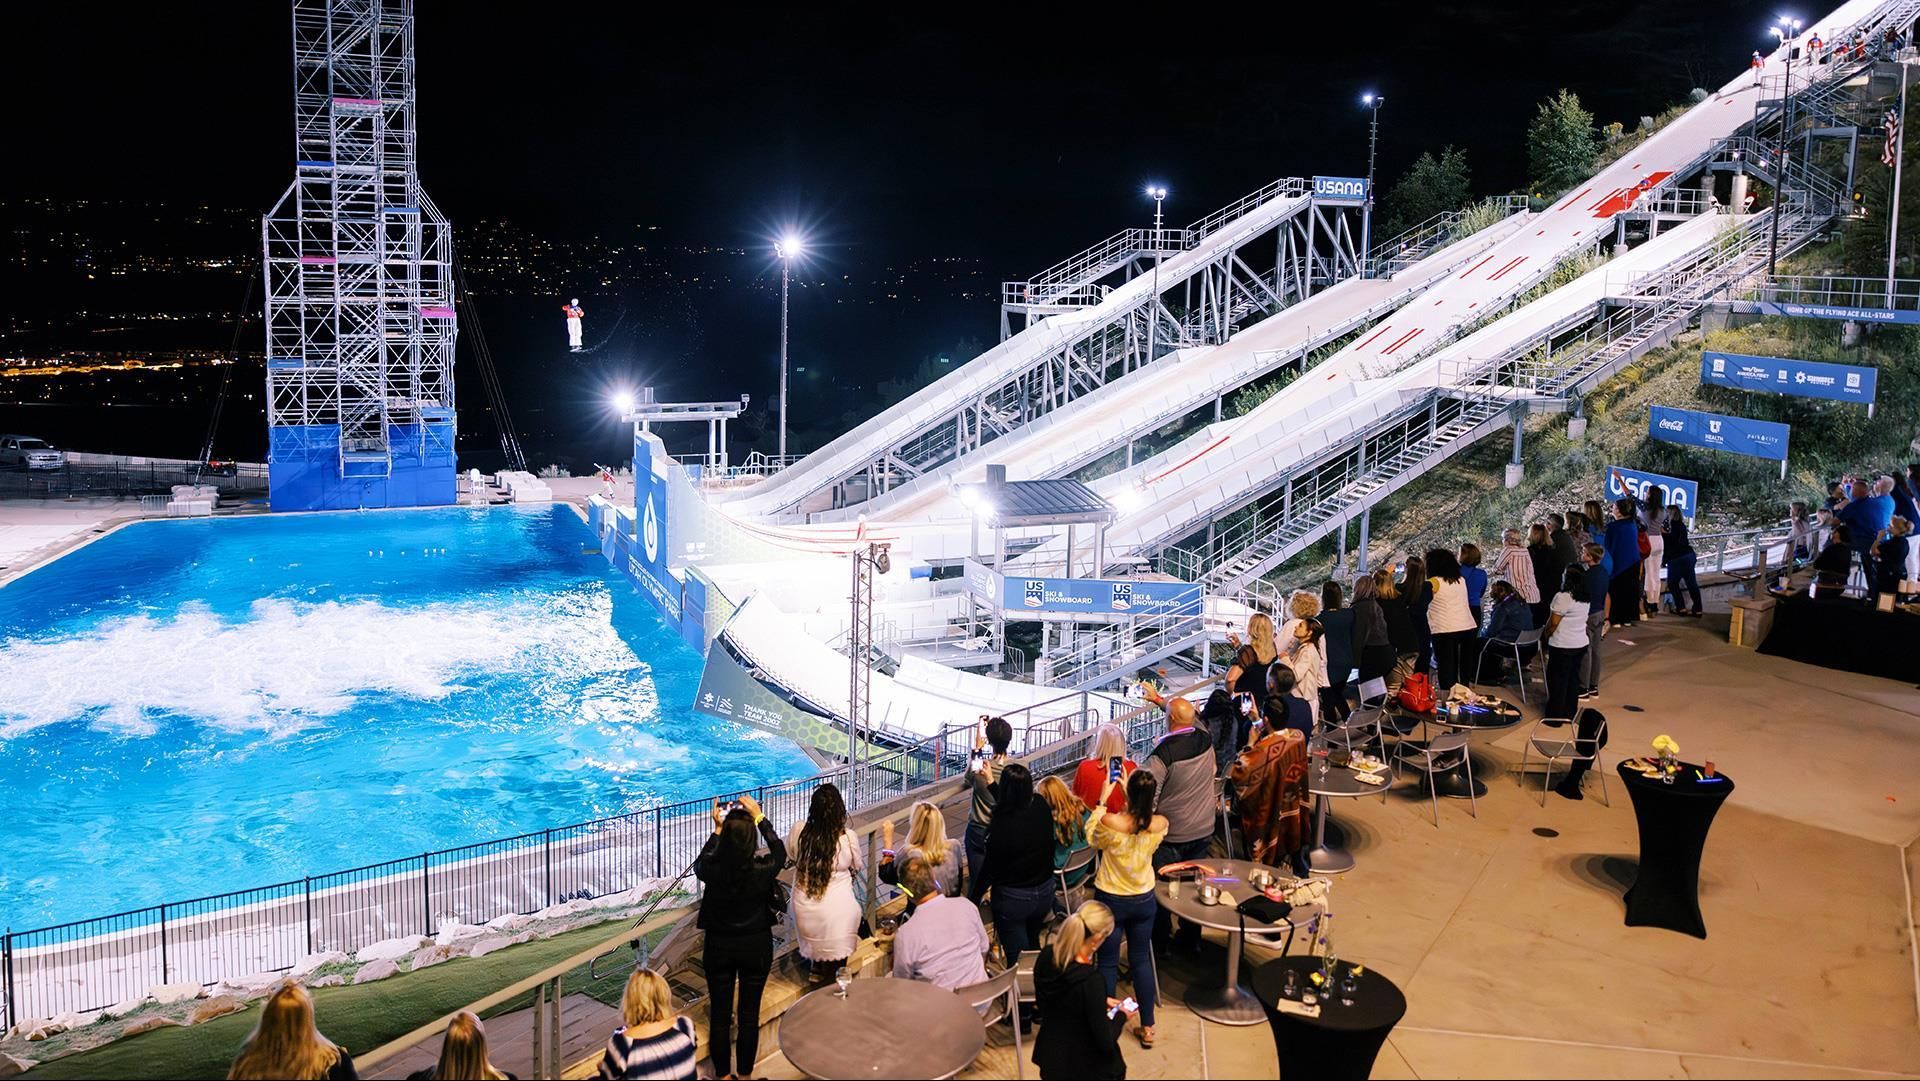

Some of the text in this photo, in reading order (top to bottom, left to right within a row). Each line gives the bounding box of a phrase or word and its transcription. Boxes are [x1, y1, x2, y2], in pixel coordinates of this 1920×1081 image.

[1316, 180, 1364, 195] USANA
[1813, 307, 1825, 315] THE
[1847, 310, 1859, 318] ACE
[1860, 311, 1895, 319] ALL-STARS
[1704, 433, 1724, 441] HEALTH
[628, 561, 642, 582] UTAH
[1026, 581, 1043, 591] US
[1113, 584, 1131, 594] US
[1045, 596, 1093, 604] SNOWBOARD
[743, 703, 767, 716] THANK
[768, 711, 783, 720] YOU
[743, 710, 763, 722] TEAM
